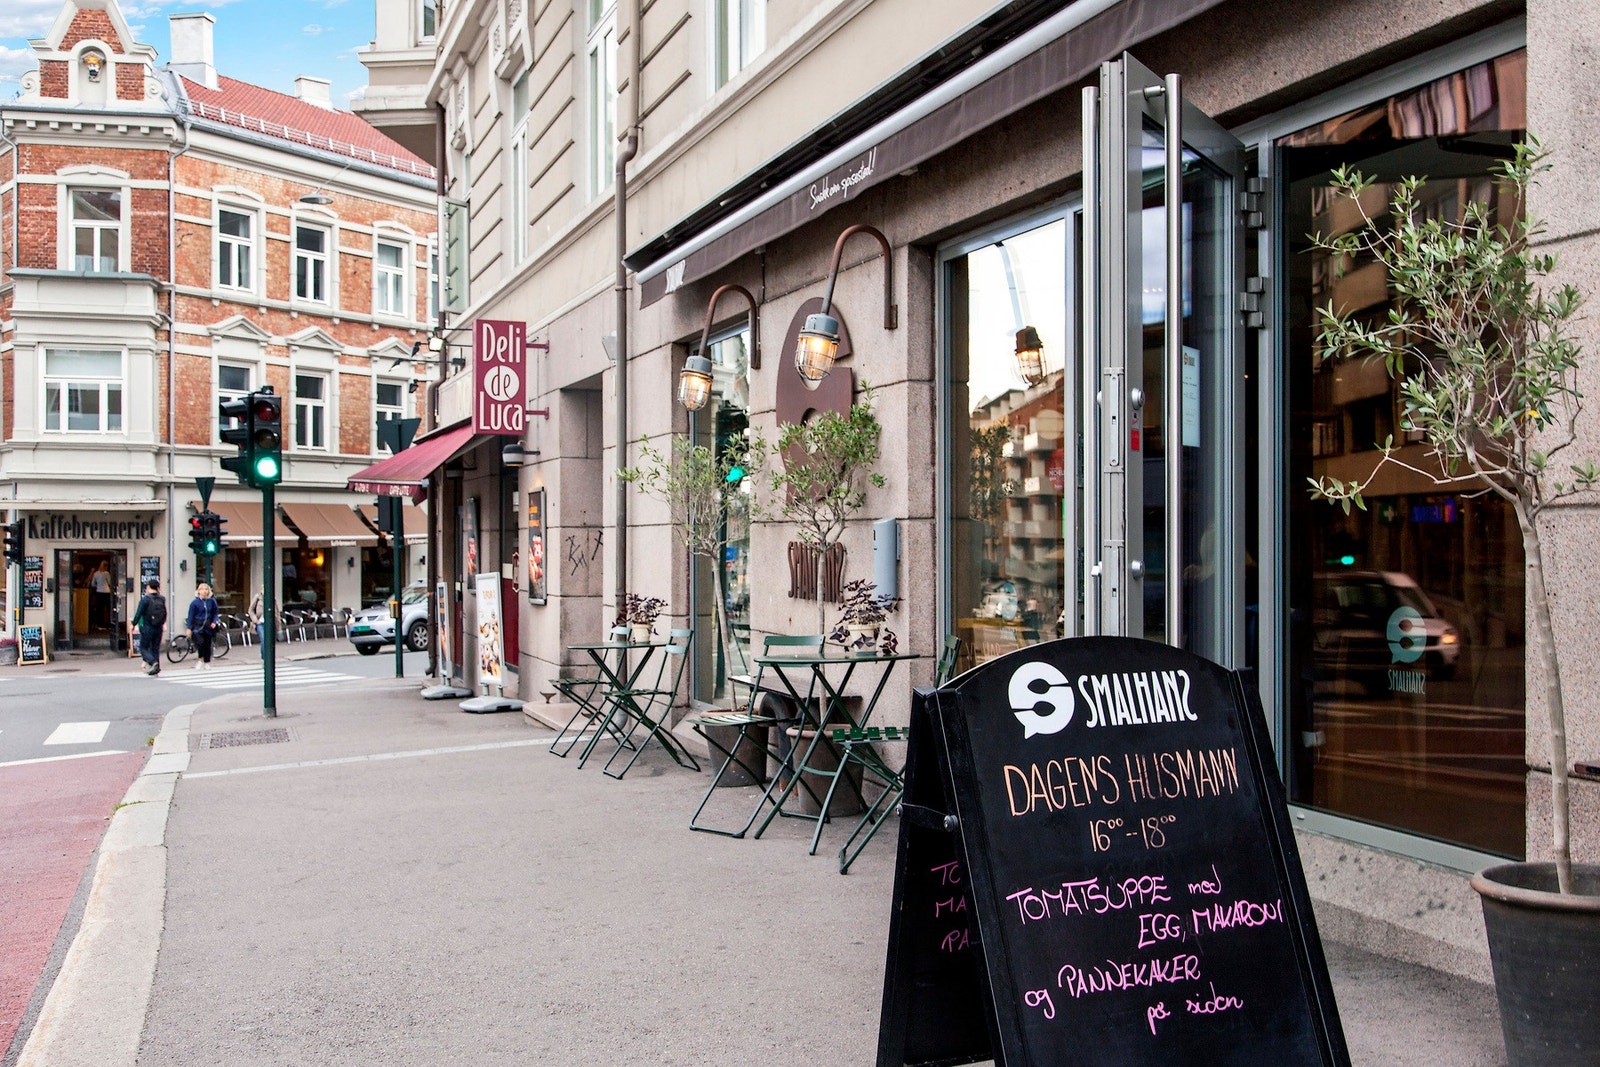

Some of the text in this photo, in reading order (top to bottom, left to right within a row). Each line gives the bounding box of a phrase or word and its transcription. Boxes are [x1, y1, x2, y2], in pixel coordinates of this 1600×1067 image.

[482, 323, 521, 363] Deli
[491, 366, 511, 398] de
[479, 391, 523, 431] Luca
[28, 514, 157, 540] Kaffebrenneriet
[1077, 669, 1198, 729] SMALHANS
[1387, 669, 1426, 695] SMALHANS
[1003, 747, 1239, 816] DAGENS HUSMANN
[1006, 875, 1172, 925] TOMATSUPPE
[1138, 899, 1284, 949] EGG, MAKARONI
[1057, 954, 1201, 998] PANNEKAKER
[1024, 988, 1056, 1020] og
